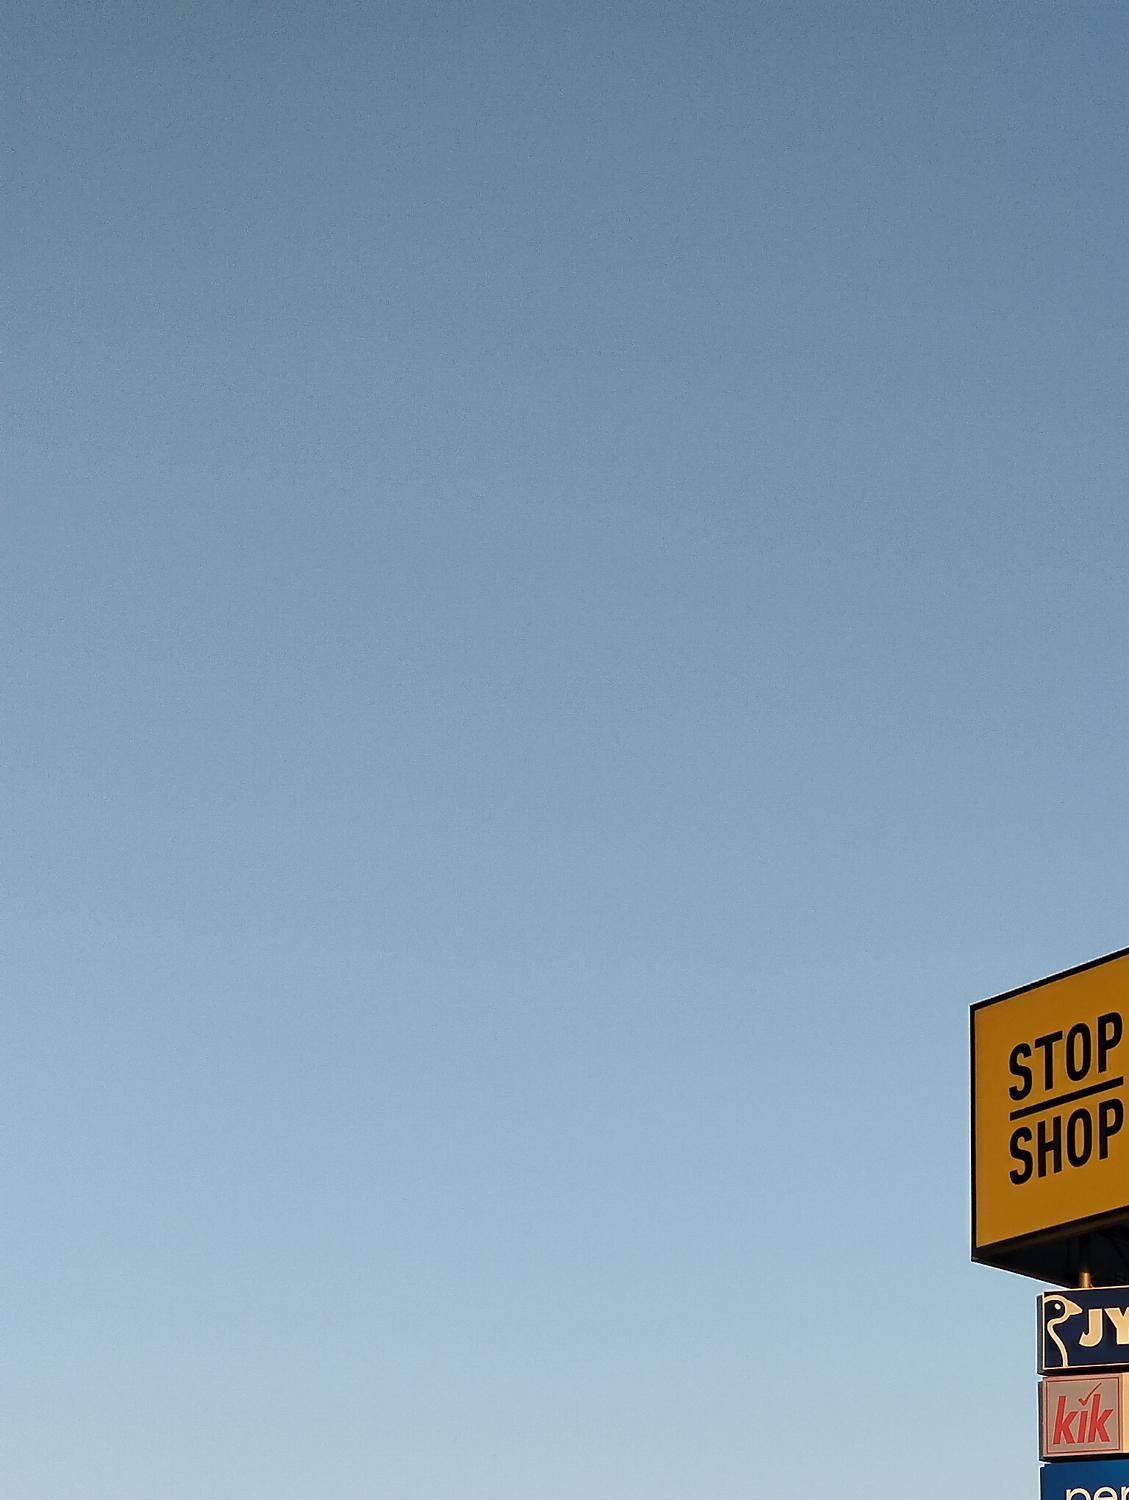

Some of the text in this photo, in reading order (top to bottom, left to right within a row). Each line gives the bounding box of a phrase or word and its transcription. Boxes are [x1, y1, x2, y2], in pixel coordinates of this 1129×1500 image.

[1009, 1011, 1124, 1101] STOP
[1009, 1098, 1124, 1186] SHOP
[1053, 1383, 1114, 1445] kik
